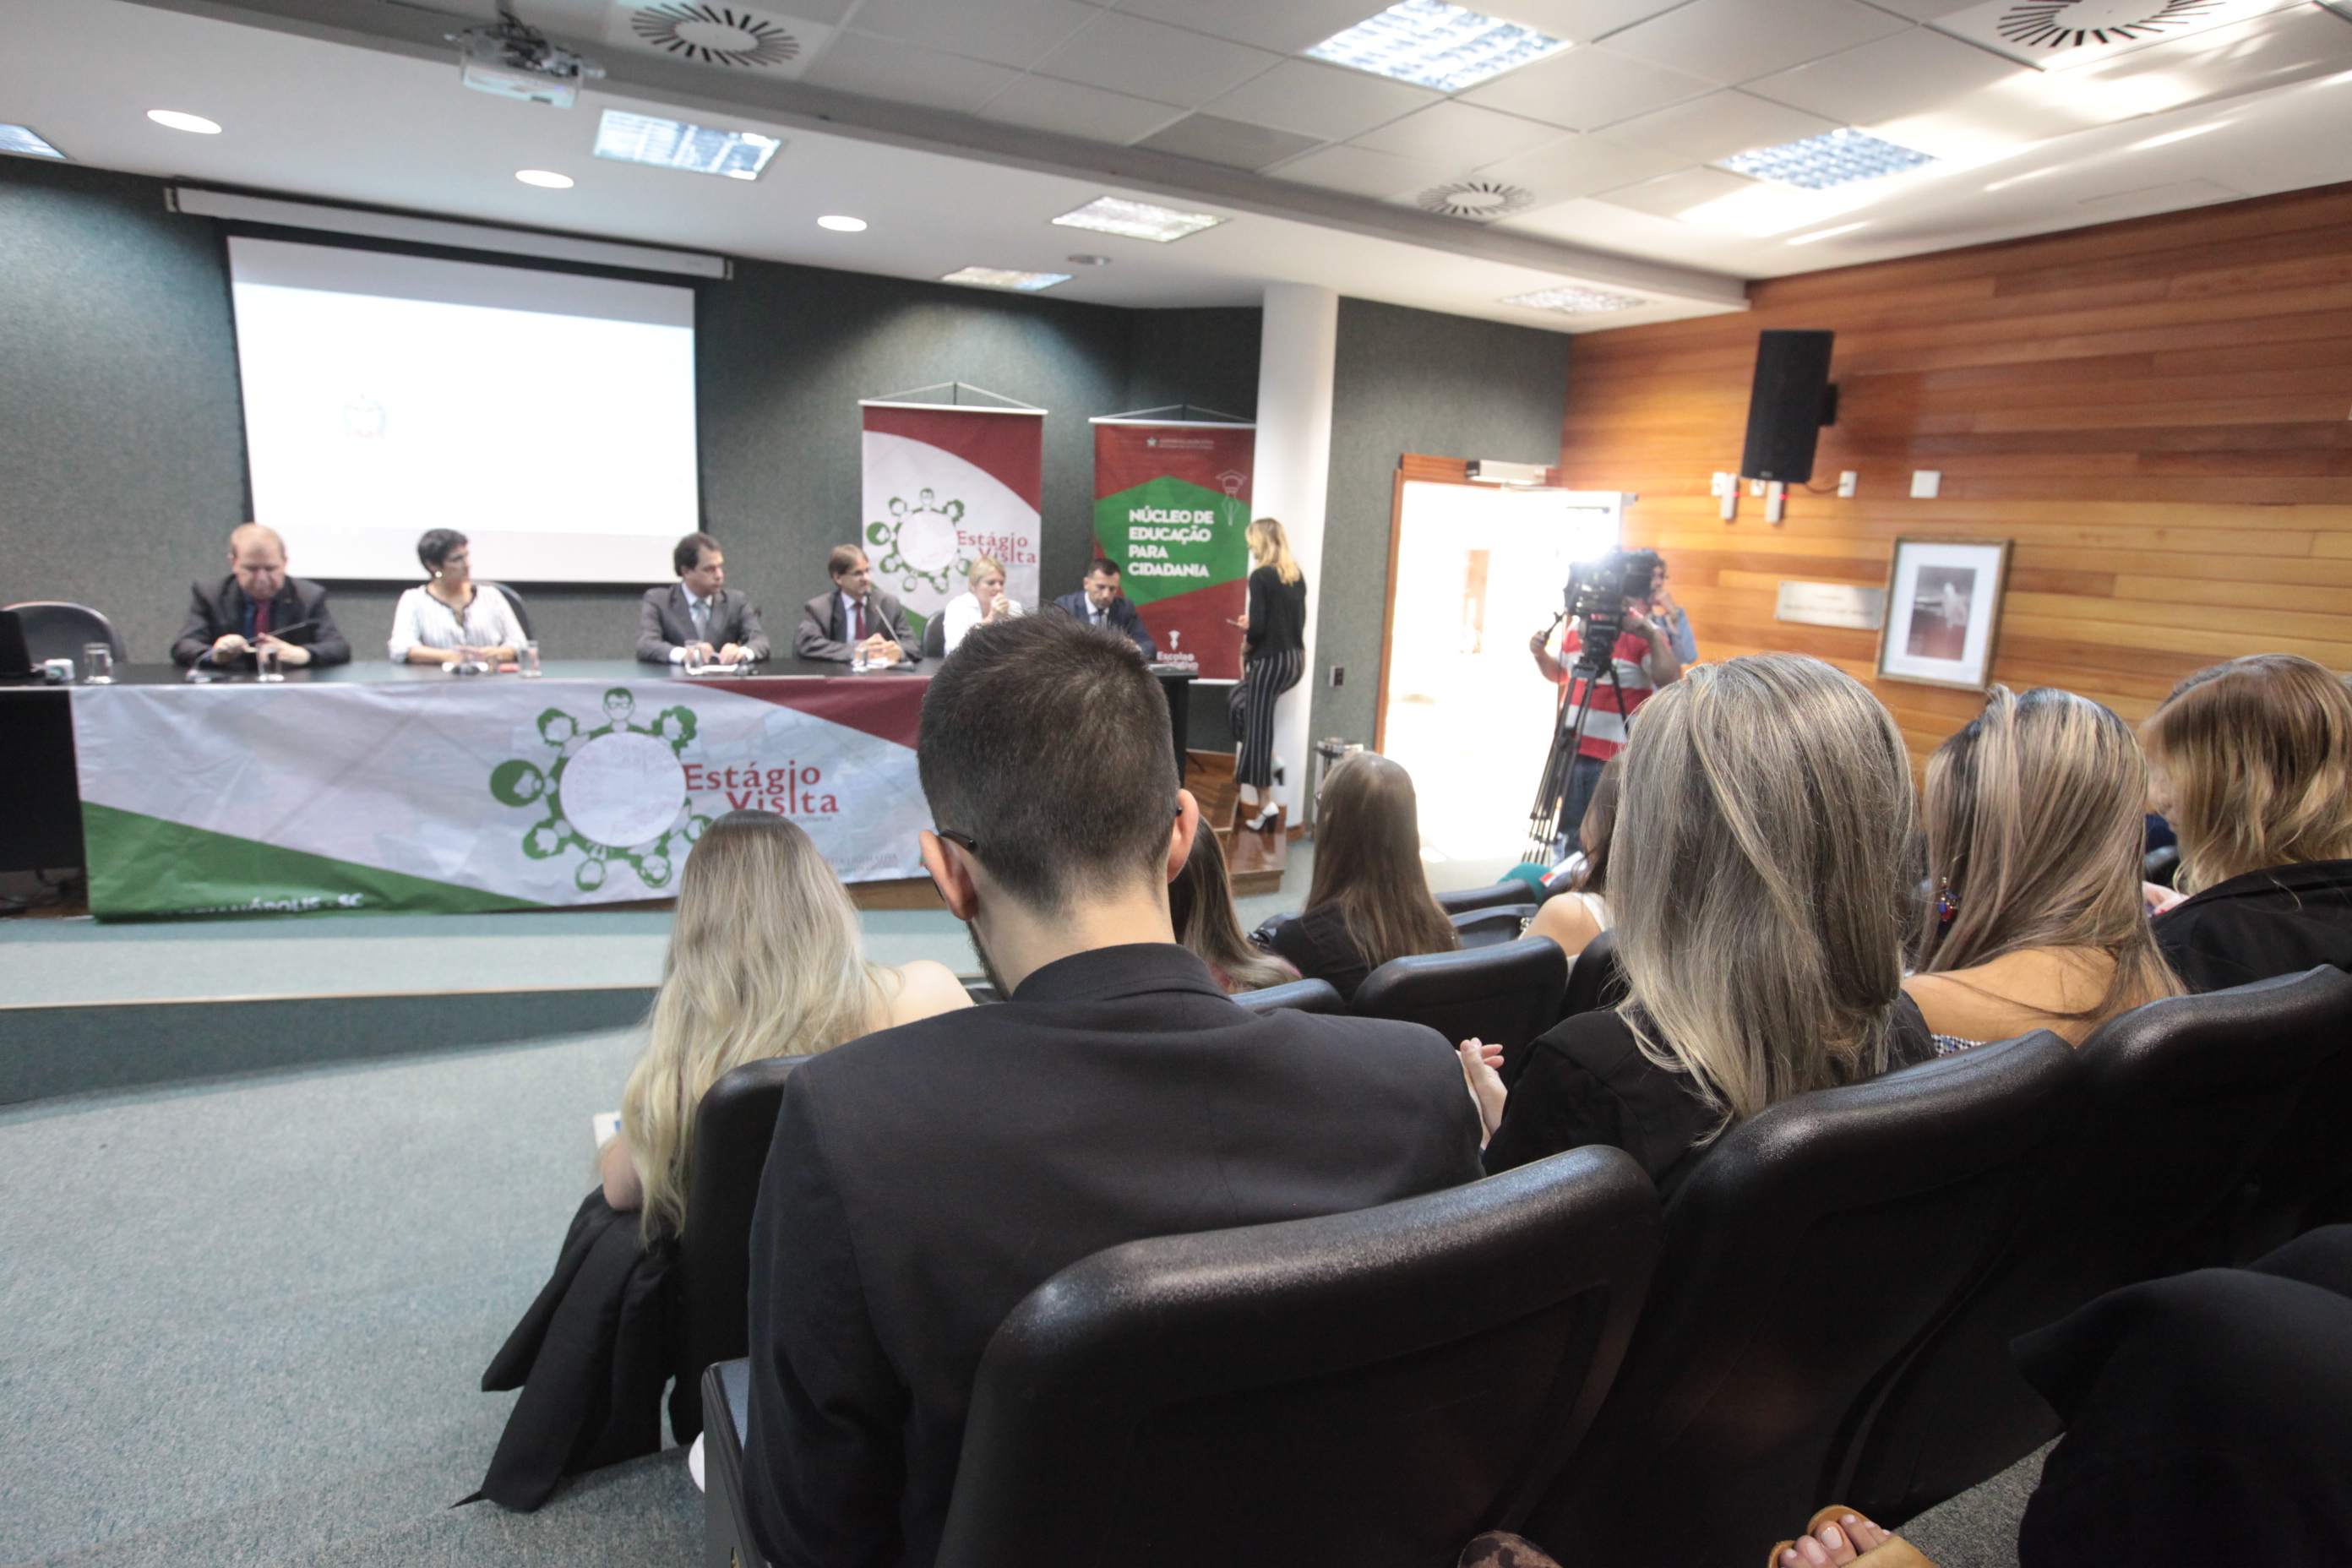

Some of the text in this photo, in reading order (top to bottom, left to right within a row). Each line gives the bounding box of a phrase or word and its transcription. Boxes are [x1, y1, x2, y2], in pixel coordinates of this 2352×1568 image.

[1129, 505, 1214, 524] NÚCLEO DE
[957, 531, 1028, 551] Estágio
[1129, 525, 1211, 545] EDUCAÇÃO
[1129, 544, 1169, 558] PARA
[1128, 562, 1210, 577] CIDADANIA
[682, 760, 821, 795] Estágio
[726, 790, 839, 814] Visita
